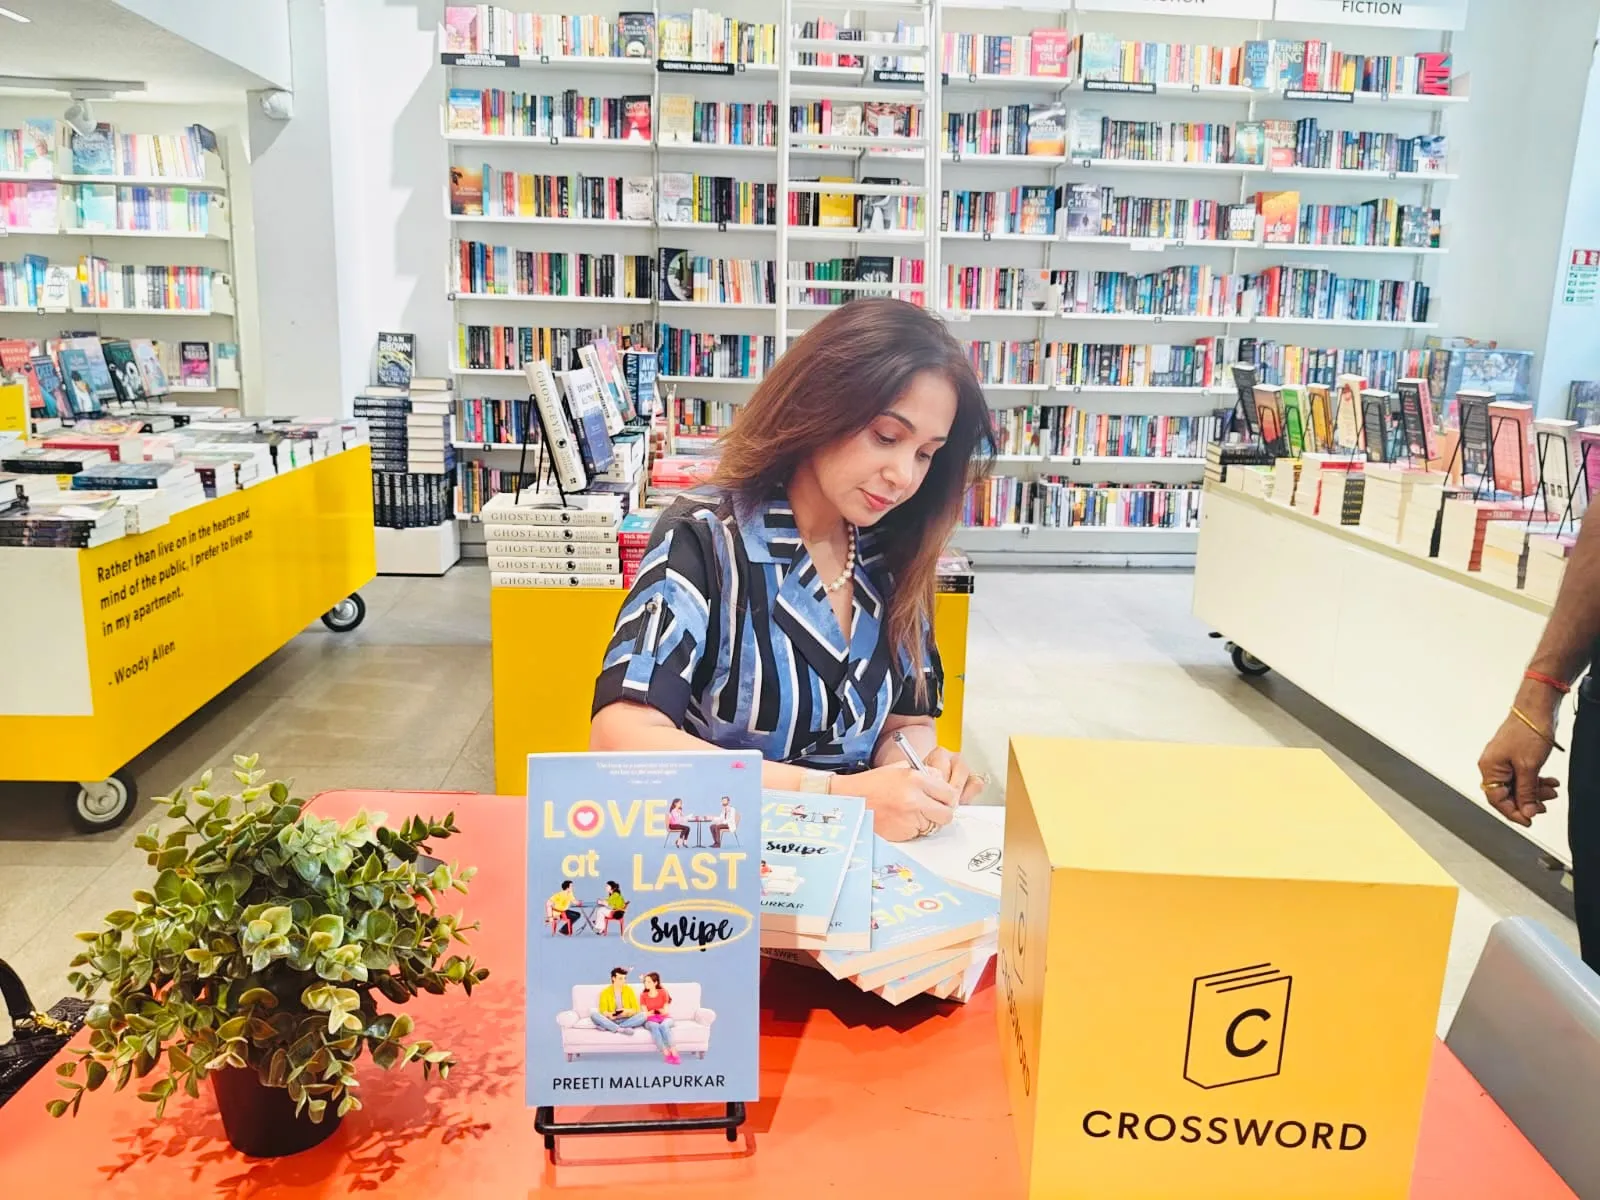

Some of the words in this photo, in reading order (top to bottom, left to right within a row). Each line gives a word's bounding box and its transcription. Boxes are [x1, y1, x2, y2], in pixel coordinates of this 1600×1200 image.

[1342, 0, 1401, 15] FICTION
[663, 62, 689, 70] GENERAL
[703, 64, 728, 72] LITERARY
[1230, 219, 1254, 230] COOK
[379, 342, 411, 352] BROWN
[386, 335, 405, 343] DAN
[536, 371, 561, 433] GHOST-EYE
[491, 512, 555, 521] GHOST-EYE
[493, 528, 559, 538] GHOST-EYE
[97, 558, 132, 583] Rather
[134, 547, 156, 567] than
[158, 541, 175, 557] live
[176, 536, 187, 549] on
[188, 530, 197, 545] in
[198, 524, 211, 539] the
[212, 515, 236, 533] hearts
[237, 508, 250, 523] and
[496, 545, 561, 553] GHOST-EYE
[100, 585, 127, 611] mind
[129, 580, 140, 596] of
[141, 574, 157, 591] the
[159, 558, 190, 585] public,
[190, 554, 194, 567] I
[195, 545, 219, 565] prefer
[220, 541, 229, 553] to
[230, 534, 244, 548] live
[244, 530, 253, 541] on
[497, 561, 562, 570] GHOST-EYE
[500, 576, 565, 585] GHOST-EYE
[102, 621, 113, 637] in
[115, 614, 131, 630] my
[133, 585, 184, 622] apartment.
[114, 655, 149, 686] Woody
[152, 640, 176, 663] Allen
[543, 799, 668, 839] LOVE
[761, 820, 847, 839] LAST
[766, 841, 829, 857] swipe
[561, 849, 600, 878] at
[632, 852, 747, 892] LAST
[651, 916, 733, 952] swipe
[1017, 911, 1025, 956] C
[1001, 949, 1031, 1097] CROSSWORD
[1225, 1008, 1272, 1058] C
[552, 1077, 604, 1090] PREETI
[609, 1074, 726, 1089] MALLAPURKAR
[1082, 1110, 1368, 1151] CROSSWORD
